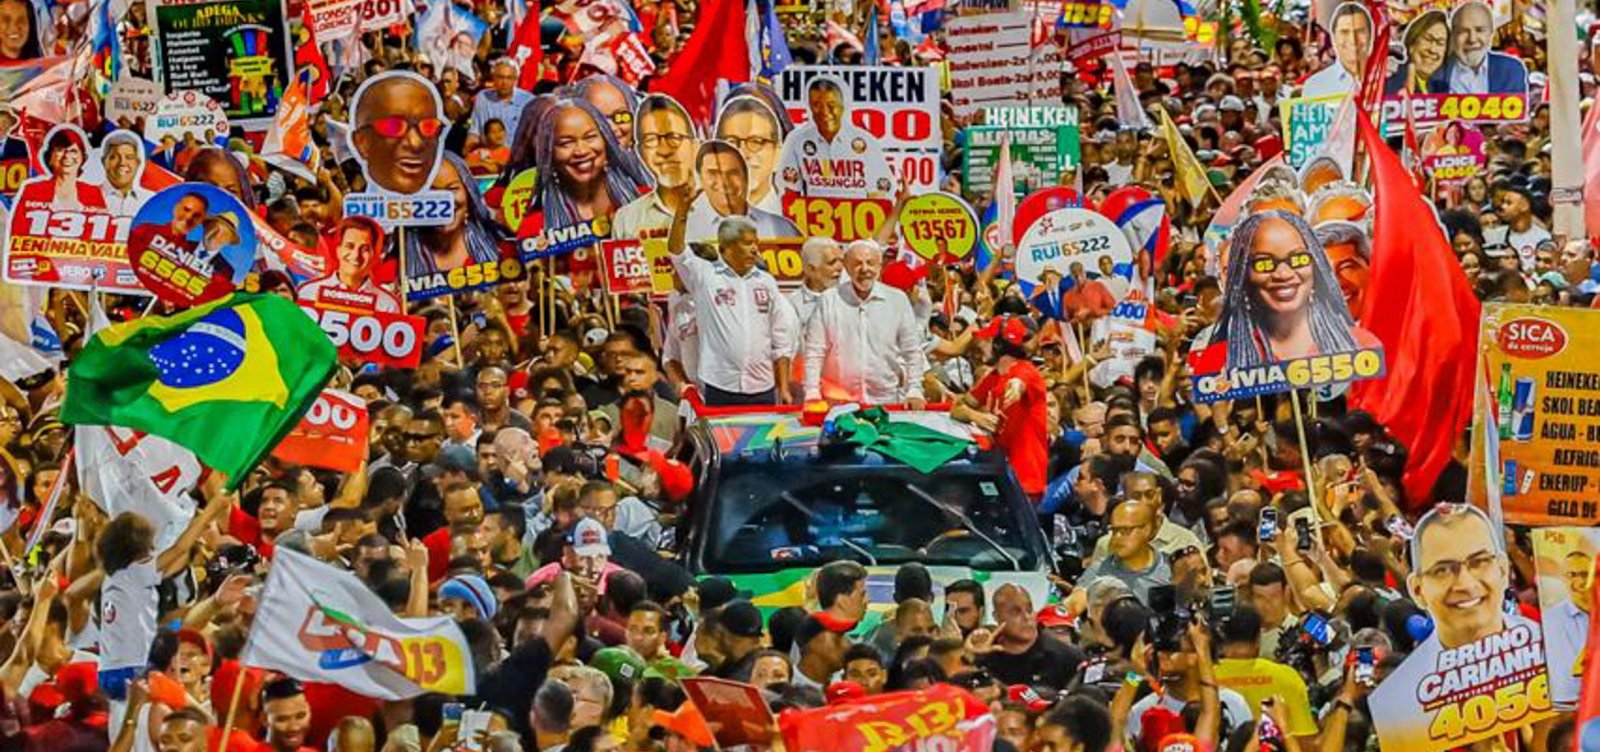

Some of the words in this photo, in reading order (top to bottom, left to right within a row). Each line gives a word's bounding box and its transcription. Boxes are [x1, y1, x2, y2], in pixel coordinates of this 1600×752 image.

[313, 6, 351, 23] FONSO
[985, 106, 1079, 127] HEINEKEN
[1440, 96, 1523, 120] 4040
[803, 159, 865, 177] VALMIR
[387, 200, 451, 221] 65222
[789, 198, 886, 240] 1310
[910, 219, 966, 240] 13567
[11, 237, 88, 255] LENINHA
[1031, 245, 1061, 263] RUI
[1061, 235, 1111, 257] 65222
[139, 249, 208, 296] 6565
[448, 258, 521, 289] 6550
[1508, 323, 1556, 342] SICA
[1287, 350, 1380, 386] 6550
[1542, 397, 1575, 415] SKOL
[1438, 625, 1532, 671] BRUNO
